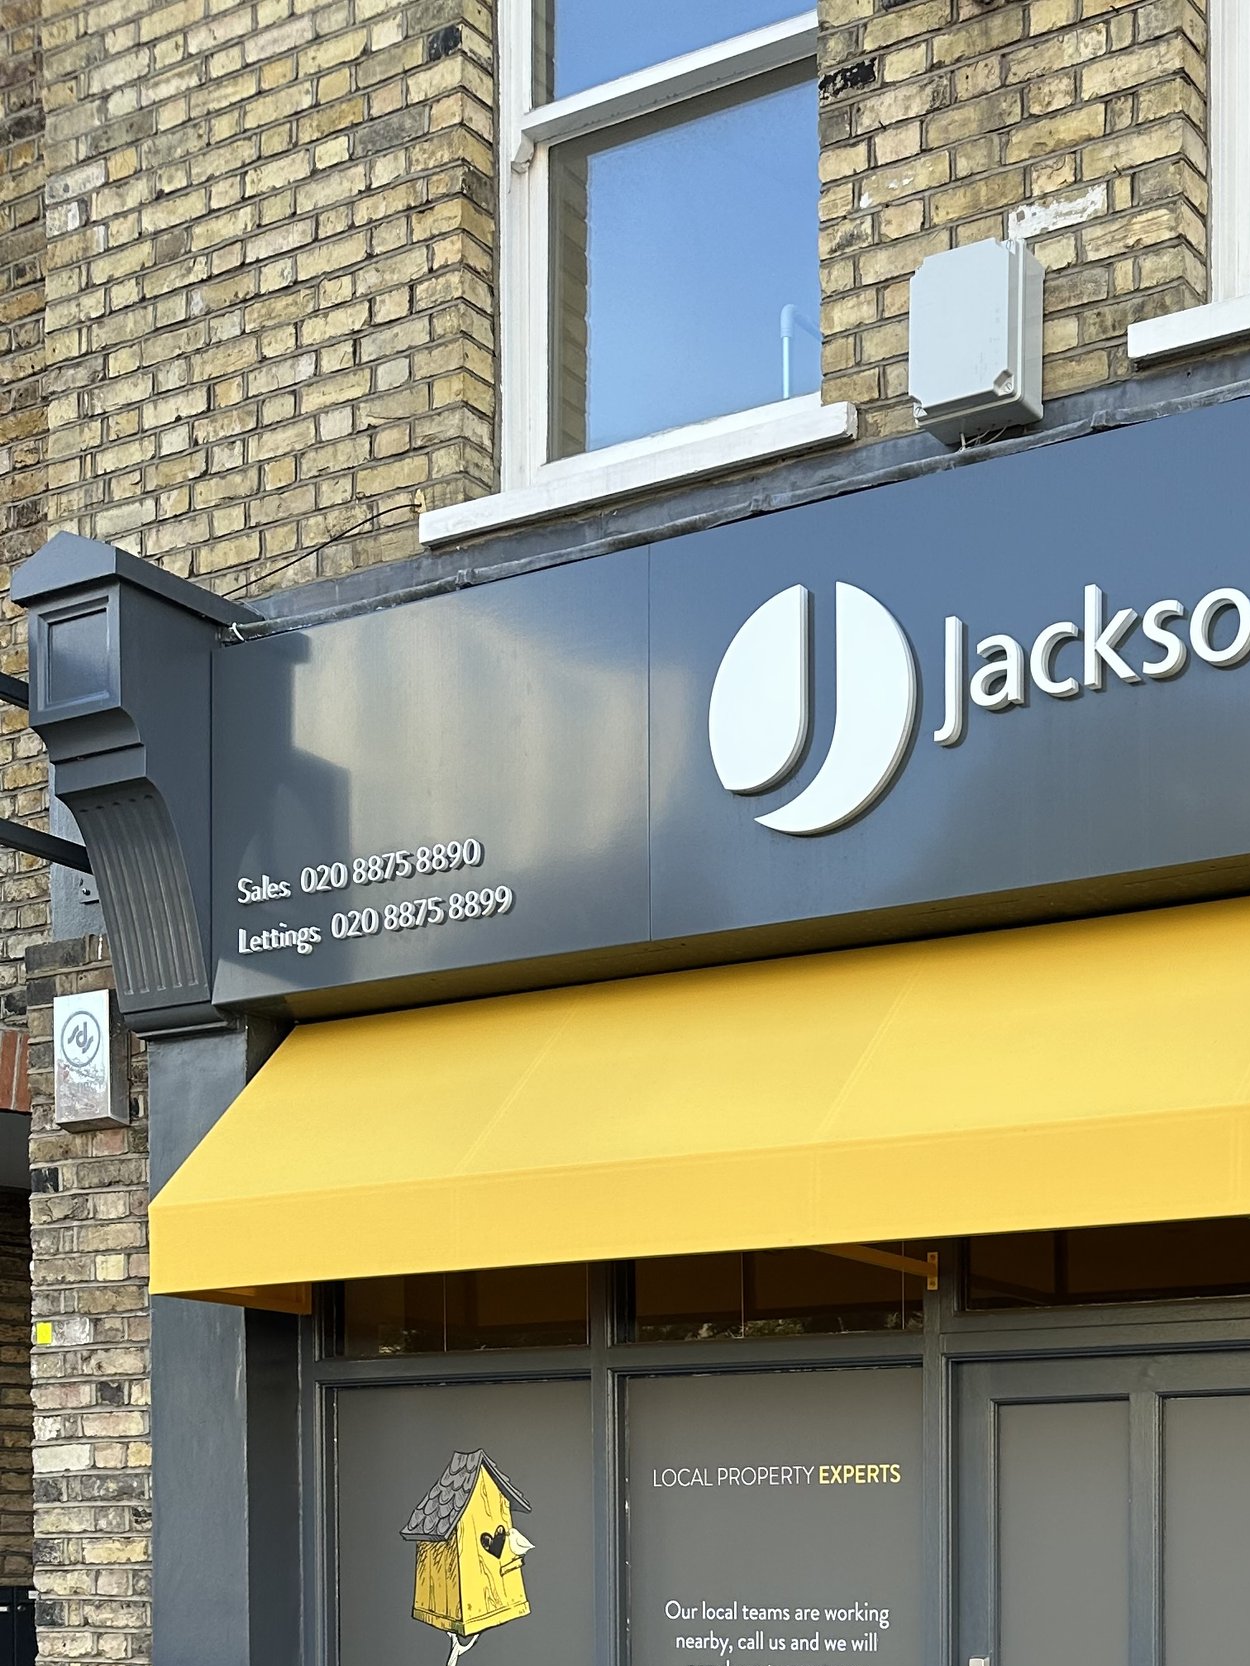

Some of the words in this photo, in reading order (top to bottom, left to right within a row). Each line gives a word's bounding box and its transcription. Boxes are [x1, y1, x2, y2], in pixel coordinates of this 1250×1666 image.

[237, 874, 292, 905] Sales
[300, 861, 348, 893] 020
[352, 850, 413, 884] 8875
[416, 838, 482, 874] 8890
[238, 922, 322, 954] Lettings
[331, 907, 379, 940] 020
[383, 896, 444, 931] 8875
[448, 885, 514, 921] 8899
[654, 1468, 713, 1487] LOCAL
[718, 1466, 814, 1486] PROPERTY
[819, 1464, 901, 1484] EXPERTS
[665, 1600, 698, 1619] Our
[703, 1601, 737, 1620] local
[742, 1605, 790, 1620] teams
[795, 1609, 820, 1621] are
[825, 1602, 889, 1629] working
[676, 1630, 733, 1656] nearby,
[738, 1631, 763, 1650] call
[769, 1638, 786, 1650] us
[791, 1632, 819, 1651] and
[824, 1639, 846, 1651] we
[851, 1632, 878, 1651] will
